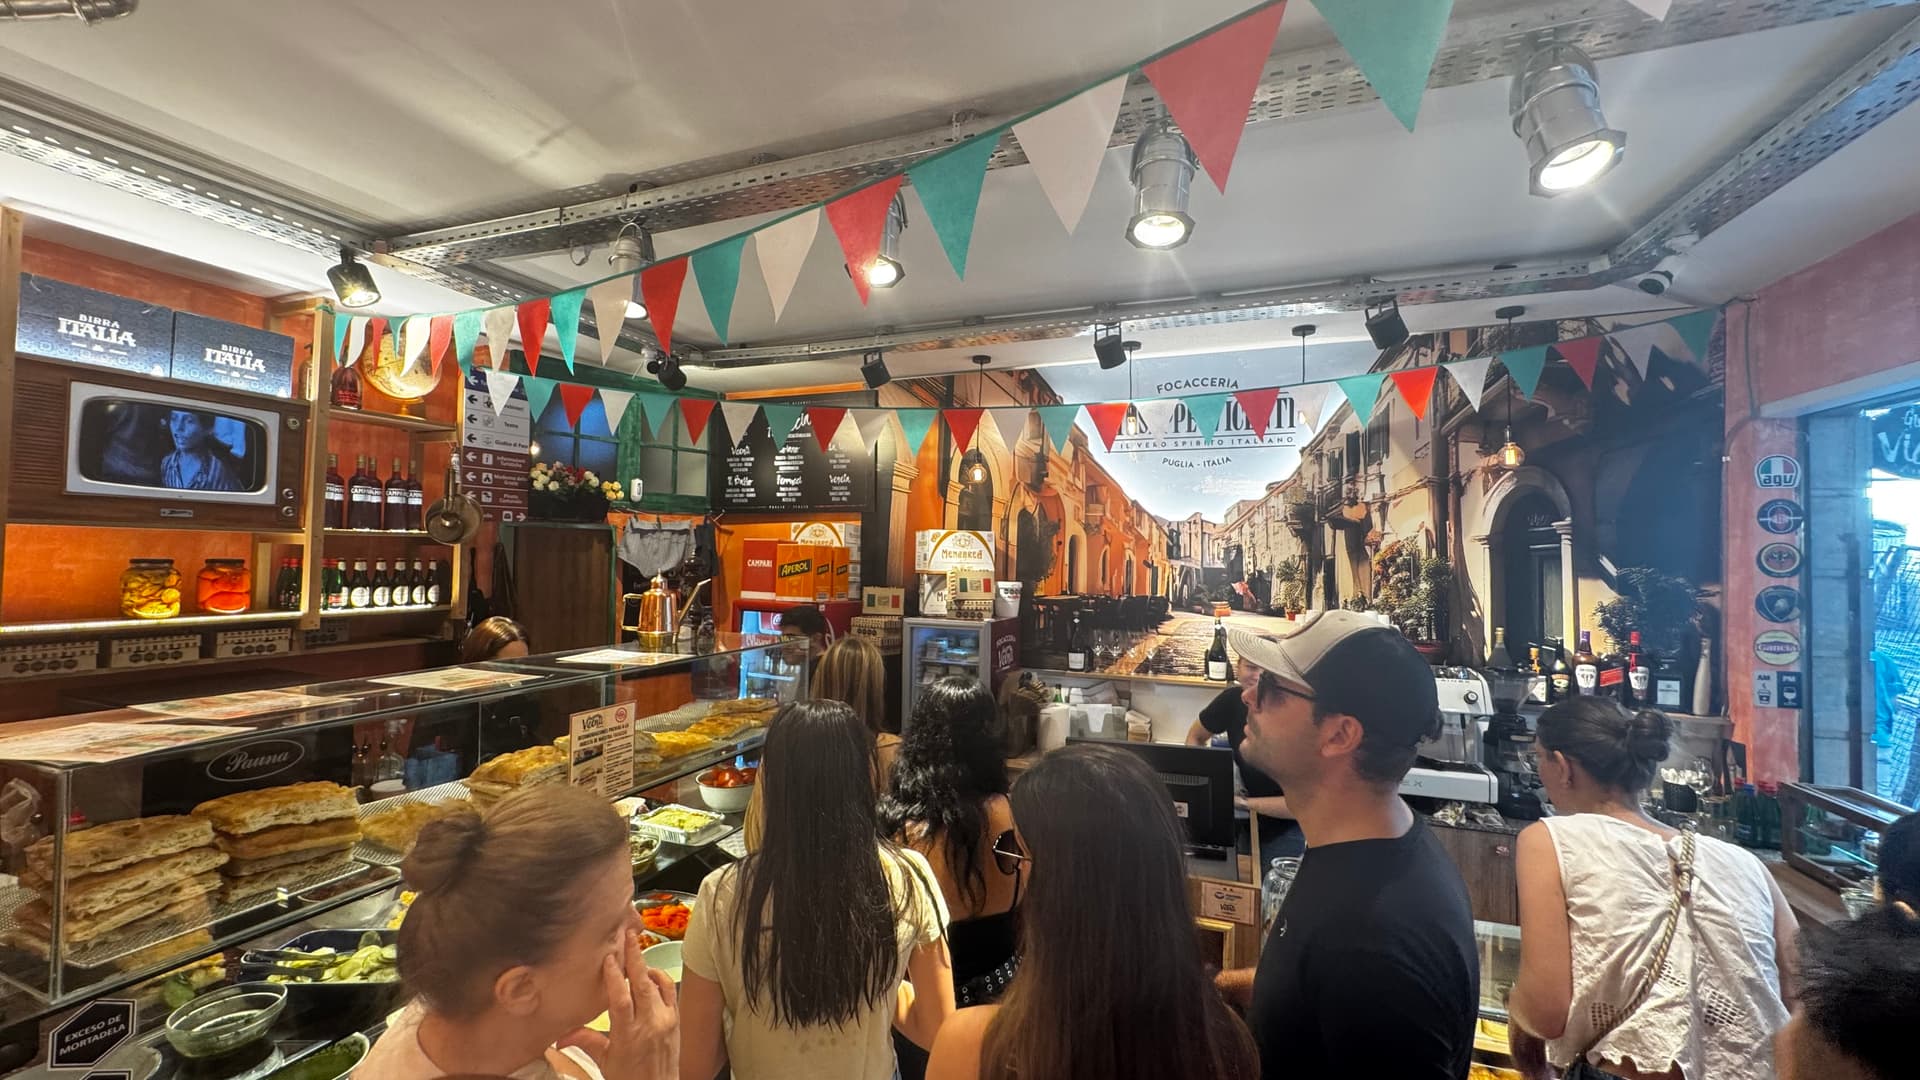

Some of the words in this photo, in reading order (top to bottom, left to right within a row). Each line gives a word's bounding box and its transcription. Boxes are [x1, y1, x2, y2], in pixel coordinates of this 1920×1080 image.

[79, 313, 120, 329] BIRRA
[57, 316, 136, 348] ITALIA
[221, 343, 253, 357] BIRRA
[204, 347, 266, 373] ITALIA
[1156, 377, 1239, 394] FOCACCERIA
[1161, 457, 1194, 468] PUGLIA
[1203, 456, 1232, 468] ITALIA
[1763, 474, 1794, 486] agv
[747, 559, 773, 568] CAMPARI
[780, 561, 808, 577] APEROL
[225, 751, 289, 773] Pauna
[64, 1020, 106, 1043] EXCESO
[107, 1014, 122, 1026] DE
[59, 1023, 126, 1056] MORTADELA
